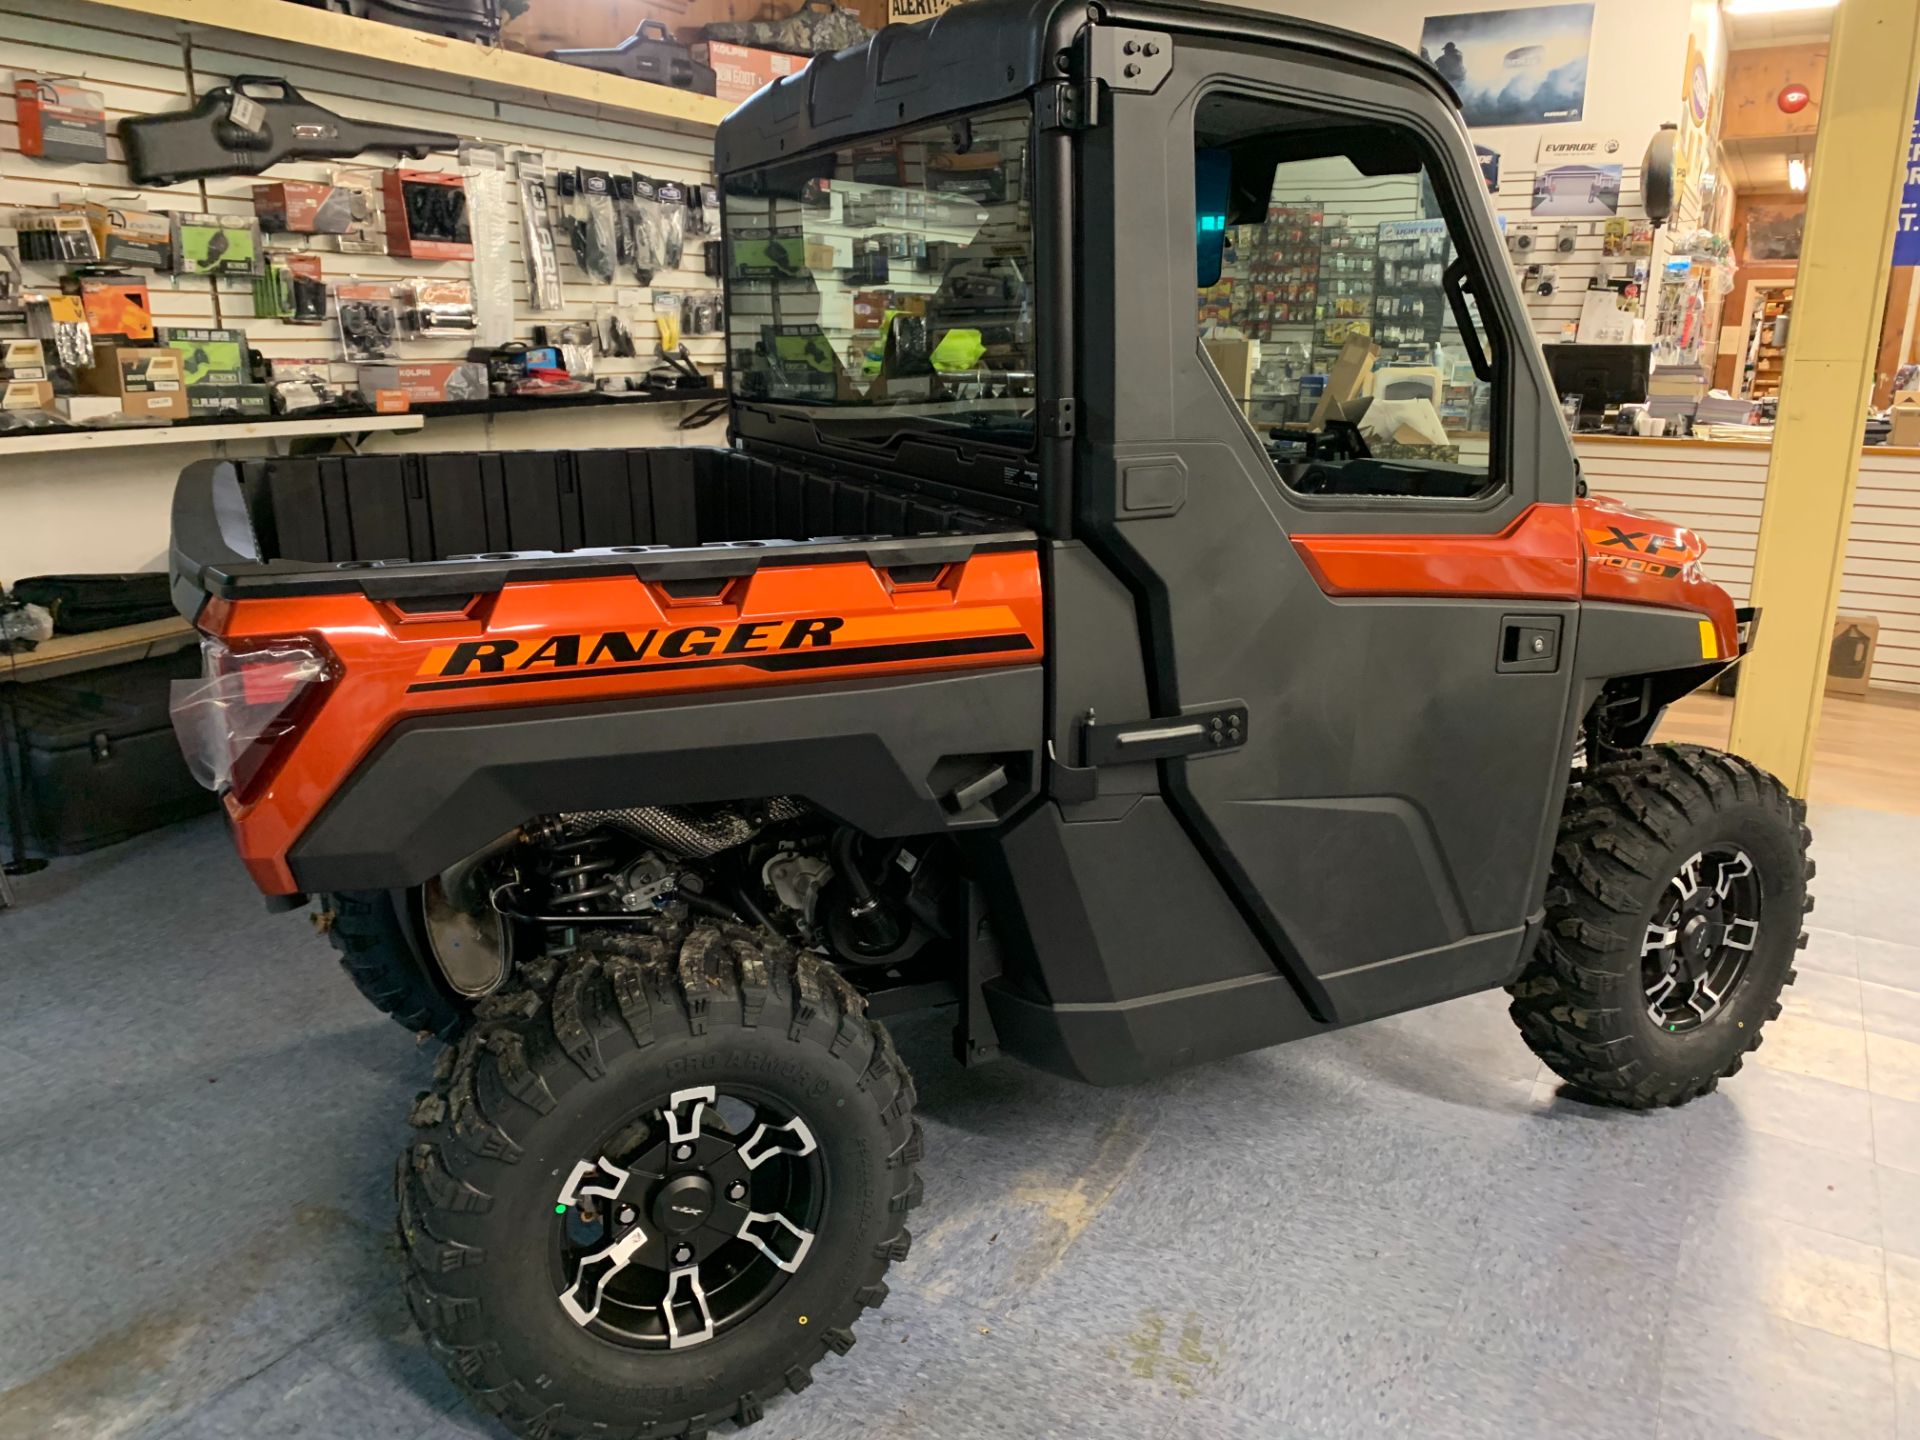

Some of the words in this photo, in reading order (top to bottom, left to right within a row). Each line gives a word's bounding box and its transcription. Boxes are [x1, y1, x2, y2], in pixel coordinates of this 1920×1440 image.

[892, 0, 939, 16] ALERT!
[712, 43, 749, 58] KOLPIN
[1545, 143, 1598, 152] EVINRUDE
[398, 368, 431, 377] KOLPIN
[1595, 525, 1688, 555] XP
[1598, 552, 1667, 576] 1000
[438, 616, 845, 677] RANGER
